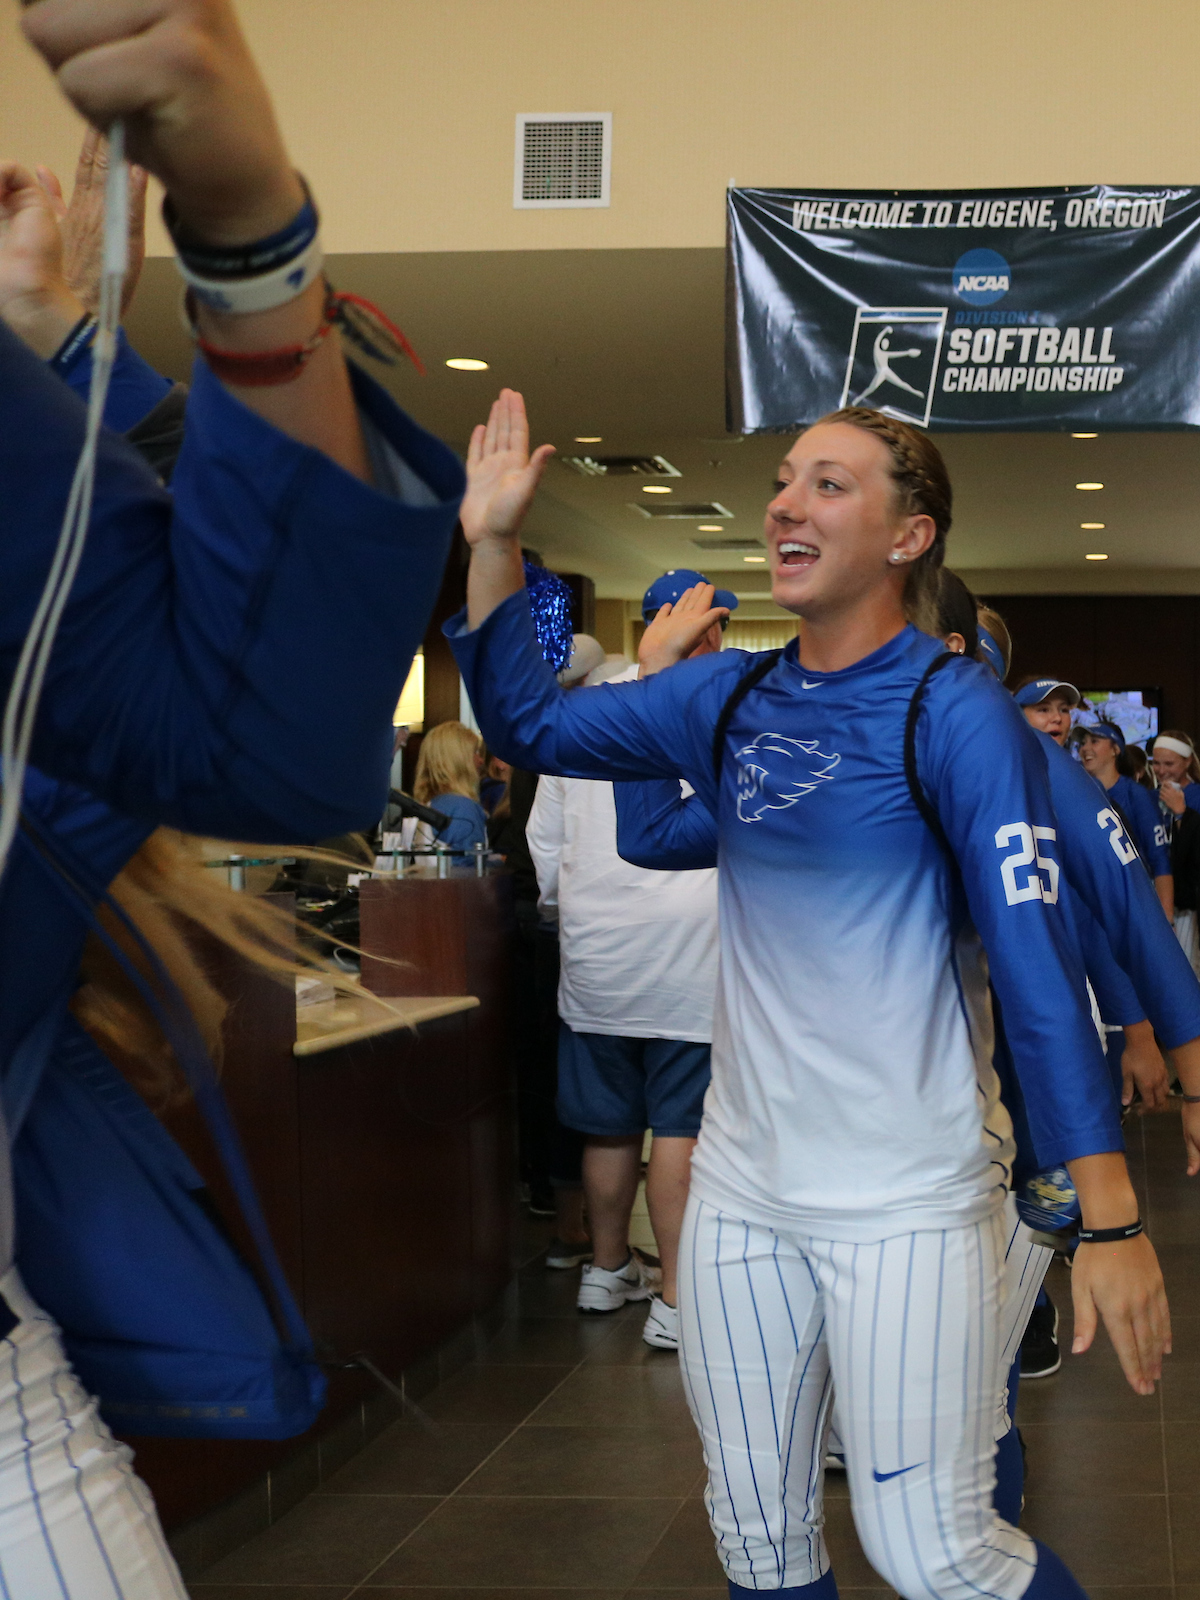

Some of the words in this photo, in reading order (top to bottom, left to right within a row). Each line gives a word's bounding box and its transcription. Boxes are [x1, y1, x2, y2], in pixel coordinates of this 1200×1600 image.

[792, 201, 917, 230] WELCOME
[922, 201, 953, 228] TO
[957, 200, 1058, 231] EUGENE,
[1064, 198, 1167, 229] OREGON
[958, 275, 1010, 291] NCAA
[954, 311, 1029, 325] DIVISION
[947, 327, 1116, 363] SOFTBALL
[942, 367, 1124, 392] CHAMPIONSHIP
[1096, 805, 1139, 866] 2
[994, 821, 1060, 907] 25
